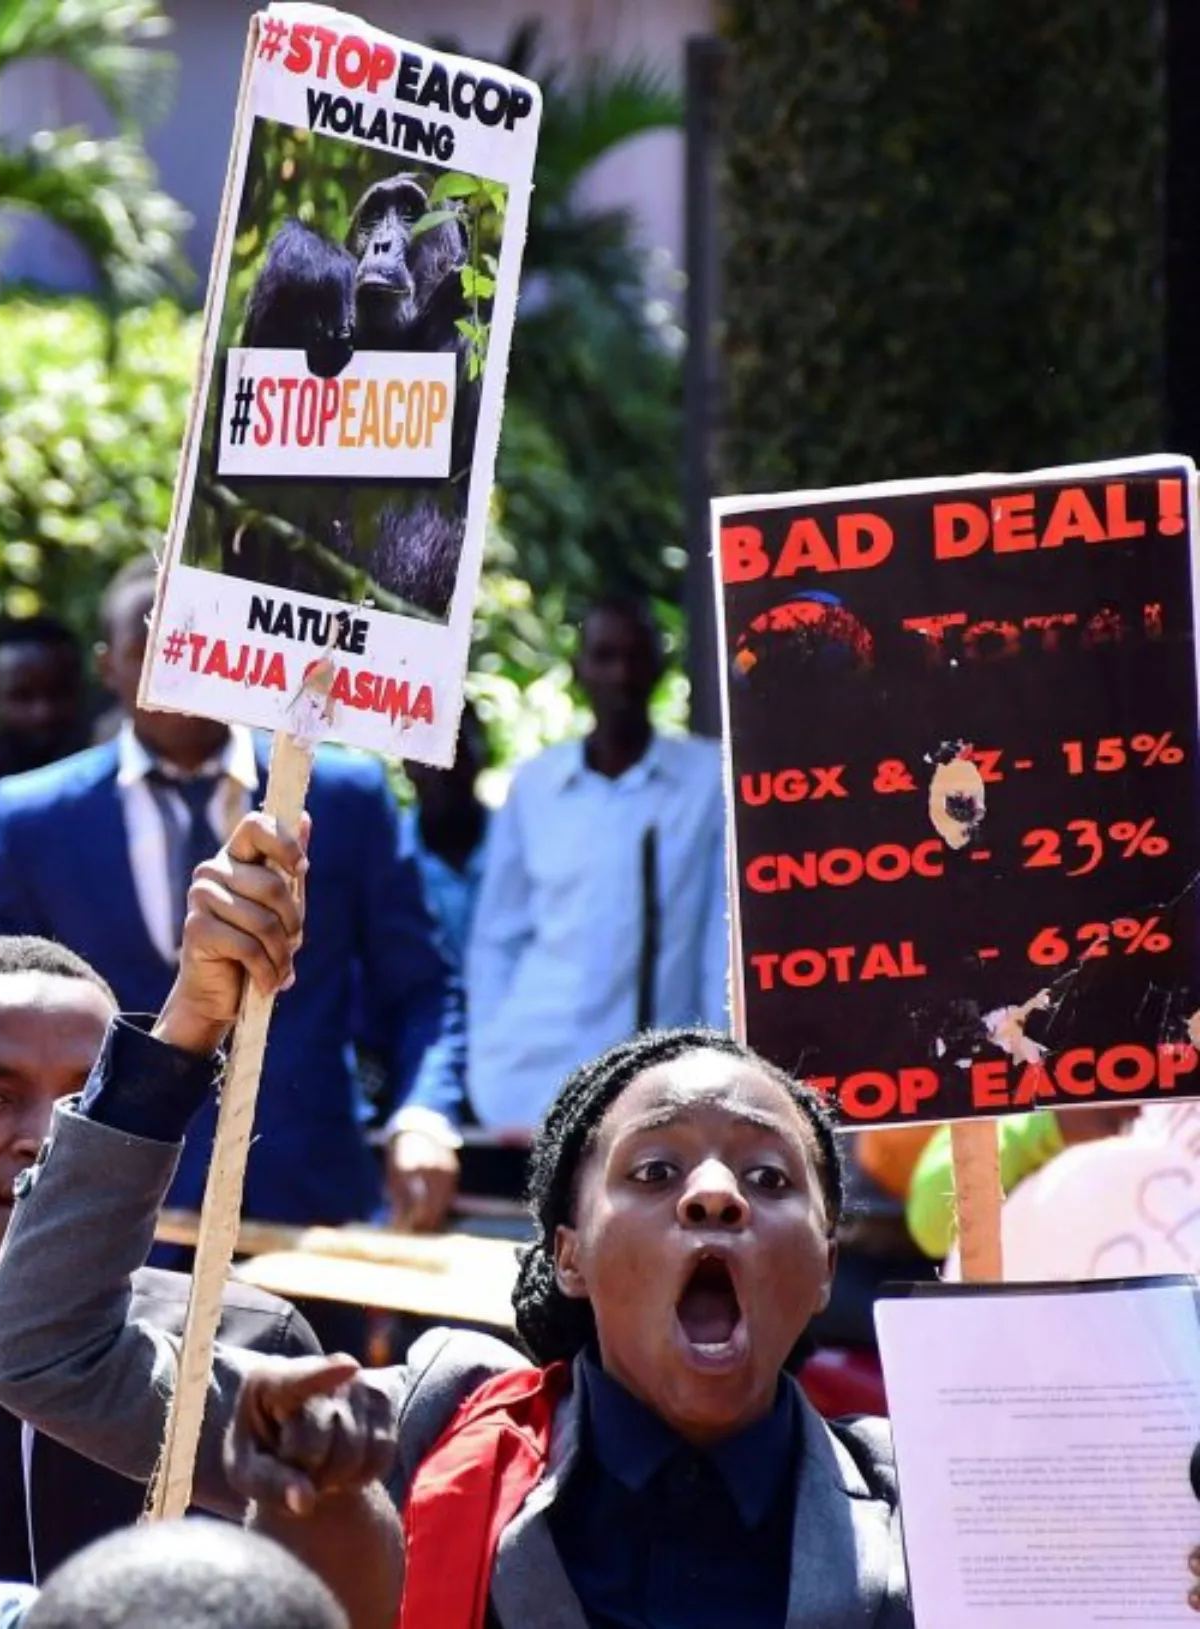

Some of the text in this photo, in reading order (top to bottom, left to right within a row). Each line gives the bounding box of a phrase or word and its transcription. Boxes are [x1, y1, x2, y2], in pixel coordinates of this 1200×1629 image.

[306, 88, 454, 161] VIOLATING
[230, 376, 448, 449] #STOPEACOP
[721, 512, 893, 585] BAD
[163, 629, 287, 692] #TAJJA
[247, 594, 370, 655] NATURE
[740, 765, 848, 807] UGX
[874, 759, 917, 793] &
[1062, 731, 1185, 776] 15%
[746, 840, 944, 893] CNOOC
[1022, 817, 1169, 877] 23%
[751, 941, 927, 991] TOTAL
[1028, 916, 1172, 966] 62%
[971, 1042, 1198, 1109] EACOP
